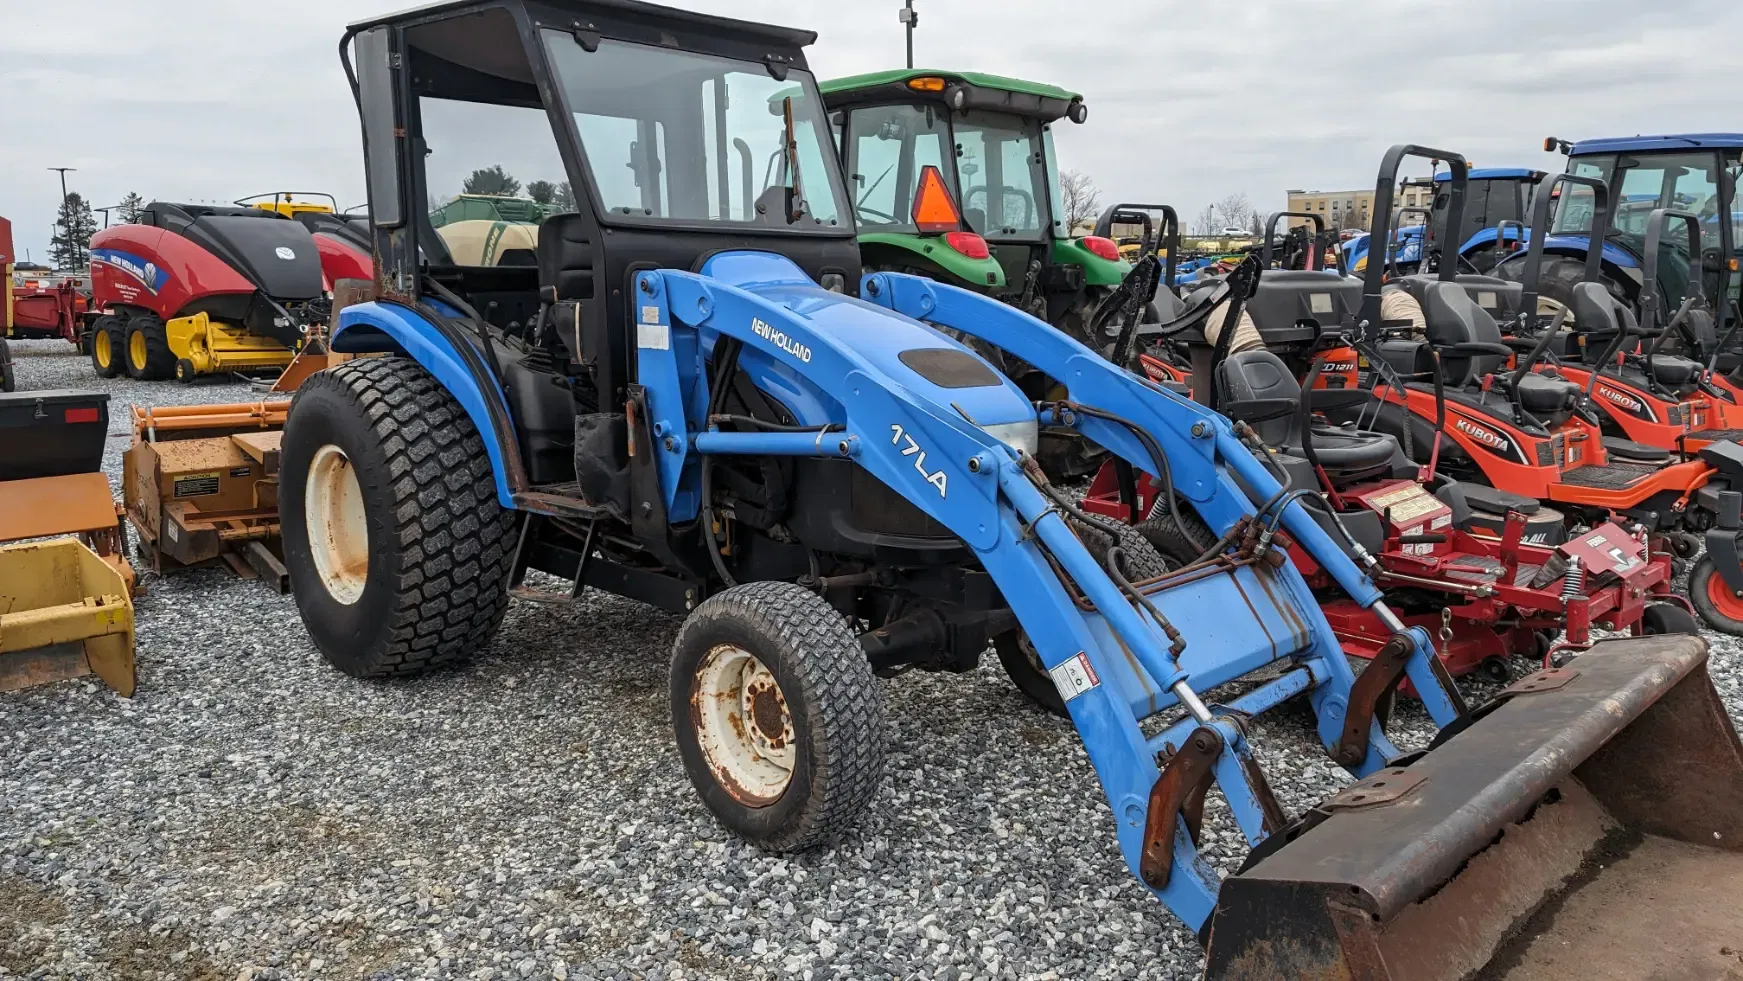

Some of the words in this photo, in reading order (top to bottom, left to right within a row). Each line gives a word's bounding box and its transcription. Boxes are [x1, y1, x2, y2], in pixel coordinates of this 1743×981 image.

[110, 254, 122, 266] NEW
[121, 258, 145, 279] HOLLAND
[751, 316, 771, 340] NEW
[770, 328, 812, 363] HOLLAND
[1599, 387, 1642, 413] KUBOTA
[1456, 419, 1508, 452] KUBOTA
[890, 424, 947, 500] 17LA
[1530, 532, 1547, 543] ALL
